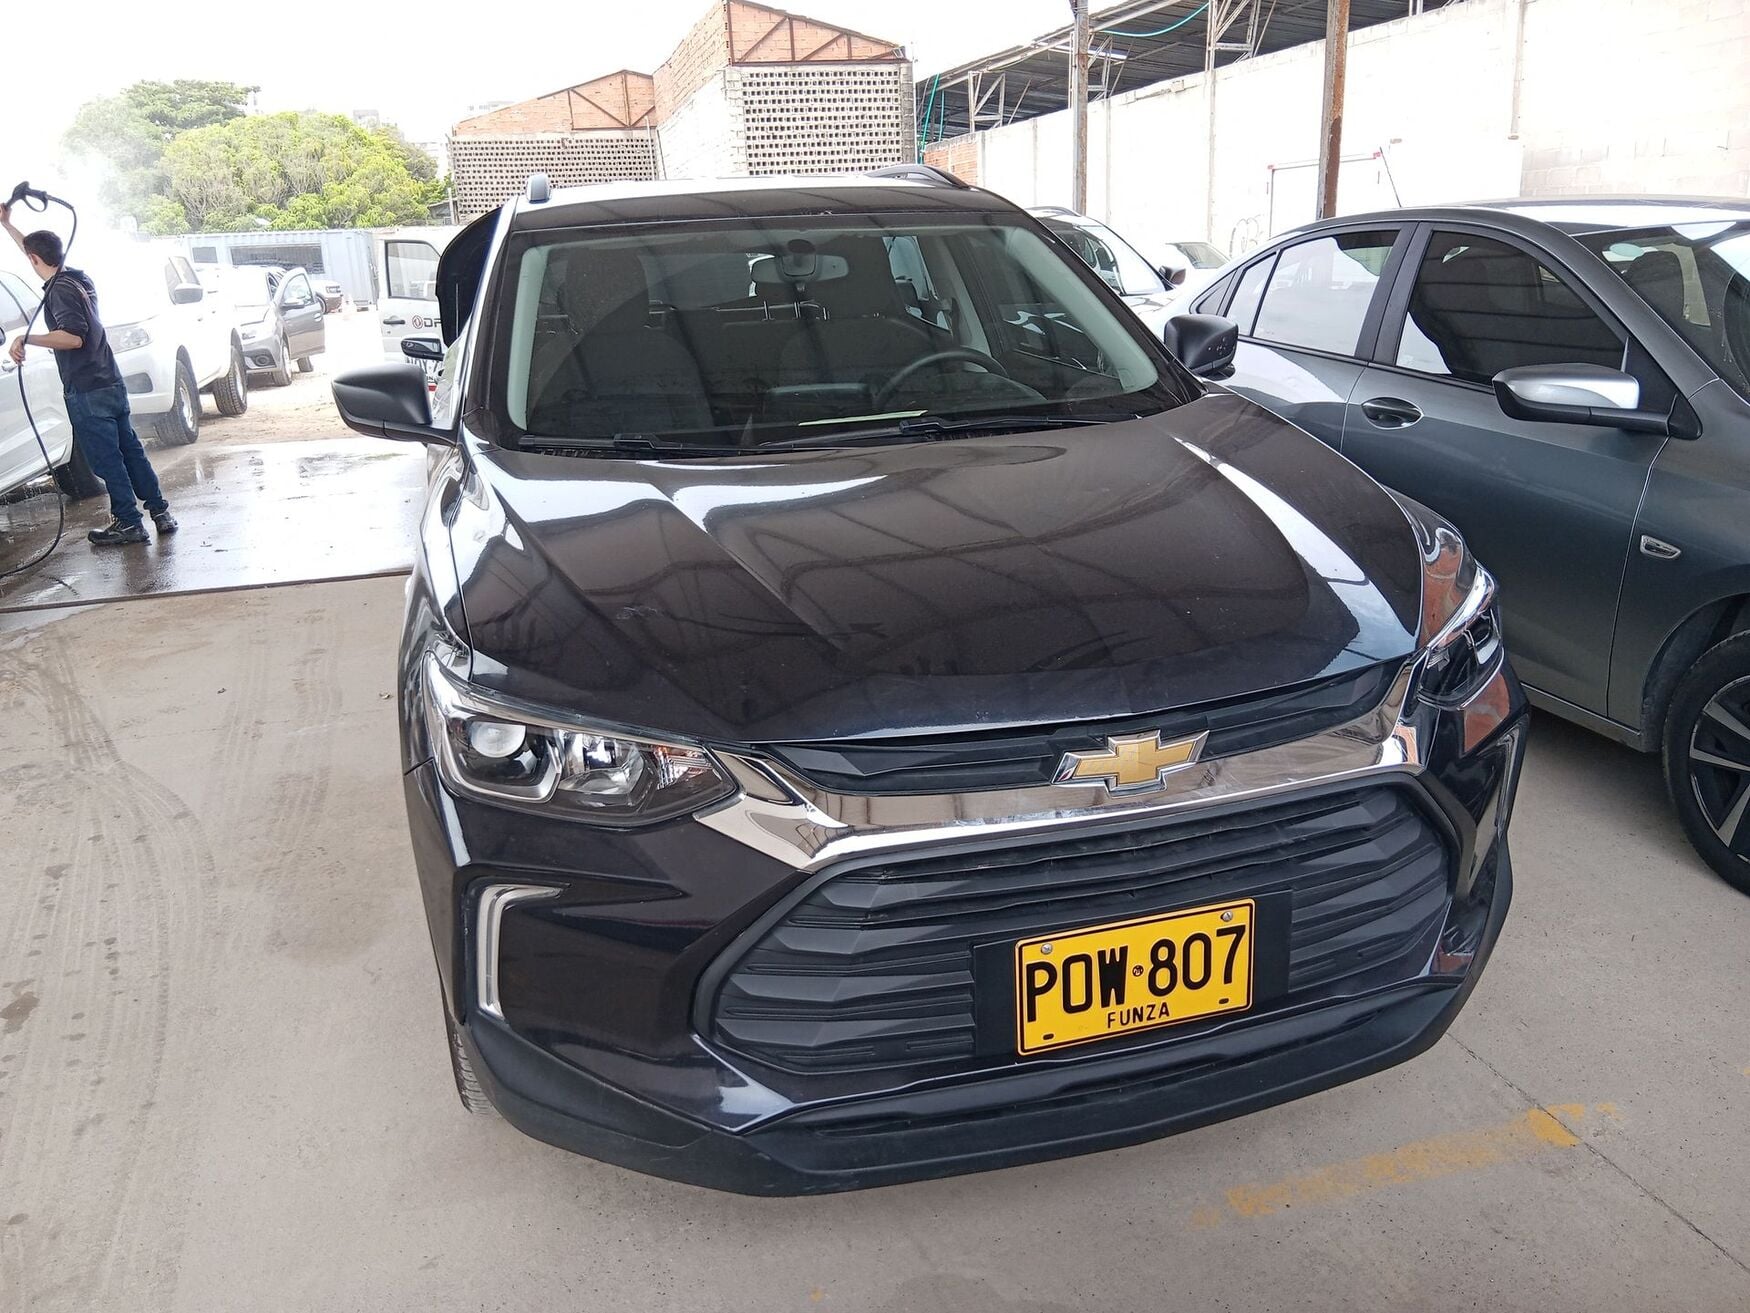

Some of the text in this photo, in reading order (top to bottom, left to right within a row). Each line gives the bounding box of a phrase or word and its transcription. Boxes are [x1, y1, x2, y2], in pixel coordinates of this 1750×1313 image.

[1025, 924, 1246, 1023] POW 807
[1107, 1001, 1170, 1029] FUNZA
